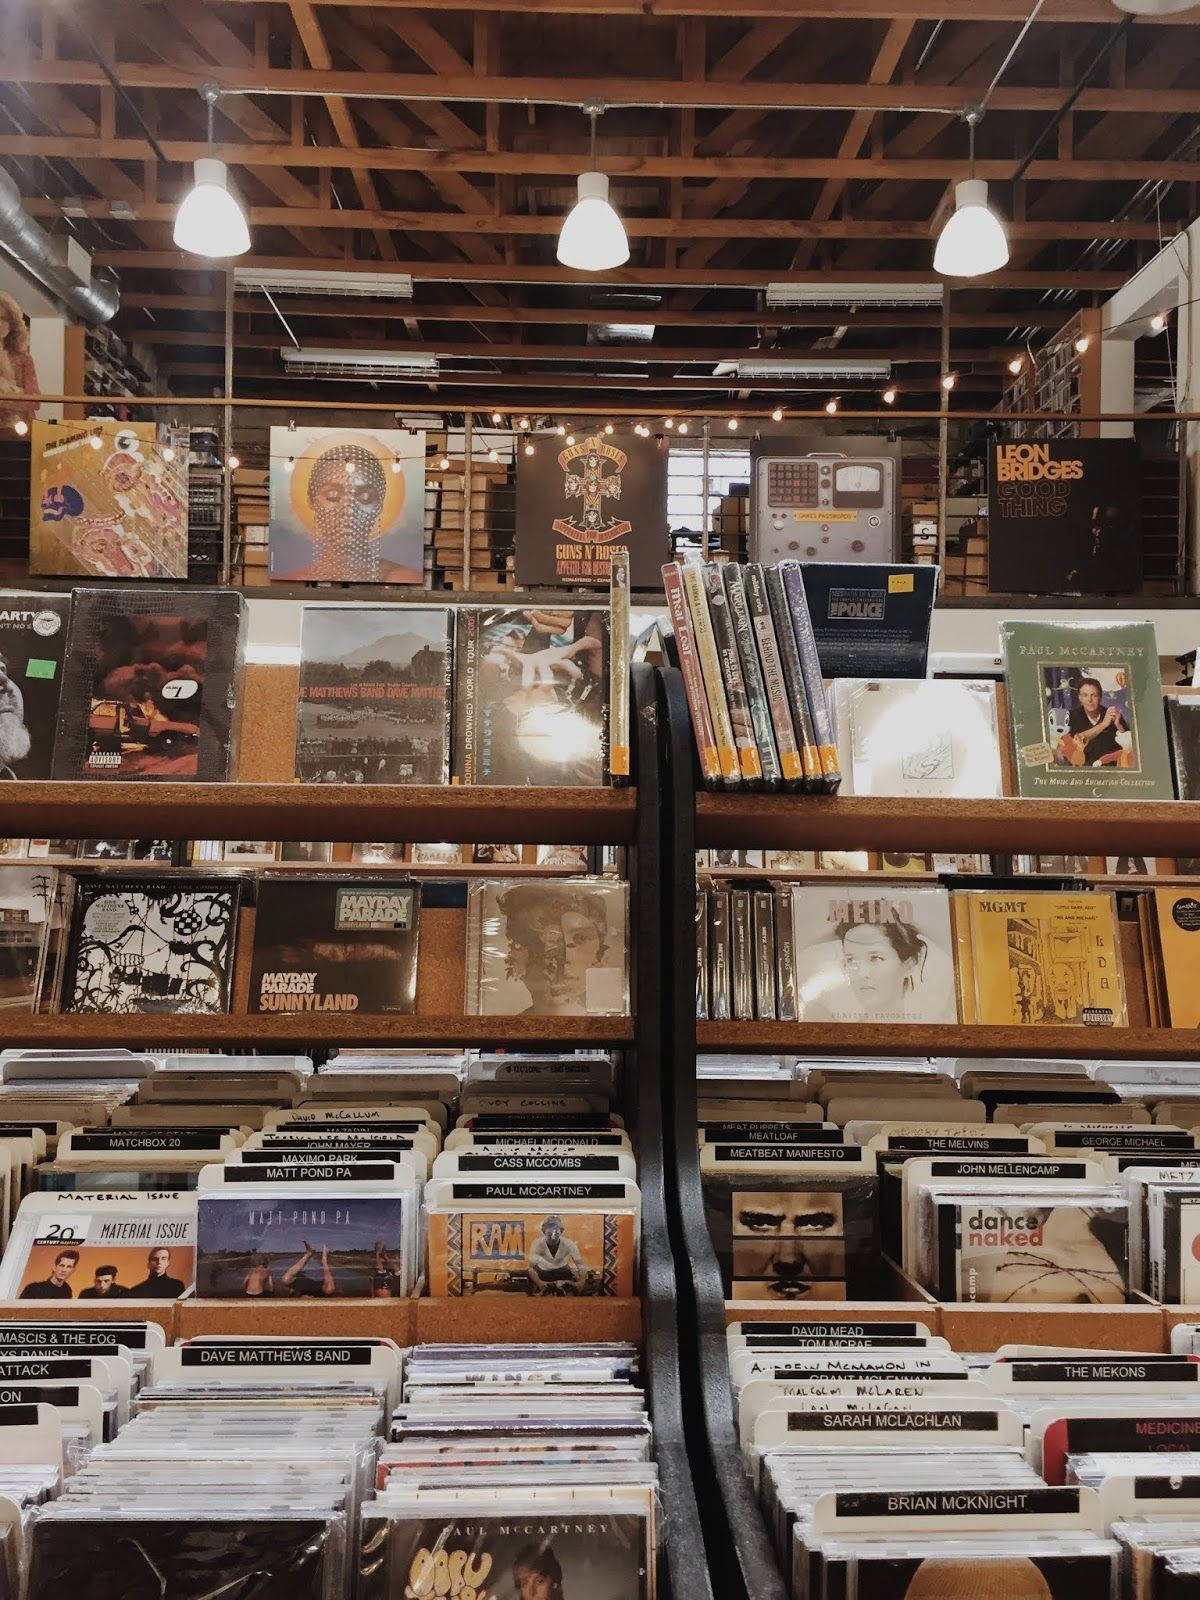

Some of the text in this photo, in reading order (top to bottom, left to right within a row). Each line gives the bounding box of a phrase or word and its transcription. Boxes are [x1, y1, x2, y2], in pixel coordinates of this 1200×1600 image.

[996, 443, 1049, 462] LEON
[997, 460, 1084, 481] BRIDGES
[998, 481, 1071, 498] GOOD
[999, 497, 1067, 518] THING
[556, 544, 582, 560] GUNS
[838, 602, 882, 617] POLICE
[467, 639, 475, 666] TOUR
[760, 637, 775, 664] BEHIND
[1019, 646, 1053, 656] PAUL
[466, 668, 475, 701] WORLD
[309, 686, 358, 698] MATTHEWS
[360, 686, 385, 698] BAND
[465, 703, 474, 749] DROWNED
[341, 896, 411, 909] MAYDAY
[979, 901, 1027, 913] MGMT
[339, 909, 407, 922] PARADE
[262, 973, 317, 983] MAYDAY
[261, 983, 314, 993] PARADE
[260, 994, 359, 1011] SUNNYLAND
[109, 1138, 181, 1147] MATCHBOX 20
[749, 1132, 799, 1141] MEATLOAF
[1082, 1137, 1166, 1147] GEORGE MICHAEL
[927, 1139, 990, 1149] THE MELVINS
[282, 1154, 358, 1163] MAXIMO PARK
[730, 1149, 845, 1158] MEATBEAT MANIFESTO
[494, 1158, 582, 1167] CASS MCCOMBS
[266, 1168, 352, 1179] MATT POND PA
[957, 1165, 1060, 1176] JOHN MELLENCAMP
[58, 1192, 180, 1202] MATERIAL ISSUE
[486, 1187, 592, 1196] PAUL MCCARTNEY
[249, 1210, 351, 1225] MATT POND PA
[969, 1210, 1039, 1230] dance
[101, 1222, 190, 1239] MATERIAL ISSUE
[969, 1226, 1044, 1247] naked
[472, 1223, 524, 1256] RAM
[792, 1327, 864, 1336] DAVID MEAD
[0, 1333, 116, 1344] MASCIS & THE FOG
[201, 1350, 351, 1362] DAVE MATTHEWS BAND
[0, 1364, 49, 1376] ATTACK
[916, 1360, 931, 1369] IN
[1064, 1367, 1146, 1377] THE MEKONS
[1, 1391, 22, 1402] ON
[823, 1415, 962, 1427] SARAH MCLACHLAN
[1136, 1422, 1200, 1434] MEDICINE
[888, 1494, 1028, 1511] BRIAN MCKNIGHT
[442, 1527, 487, 1537] PAUL
